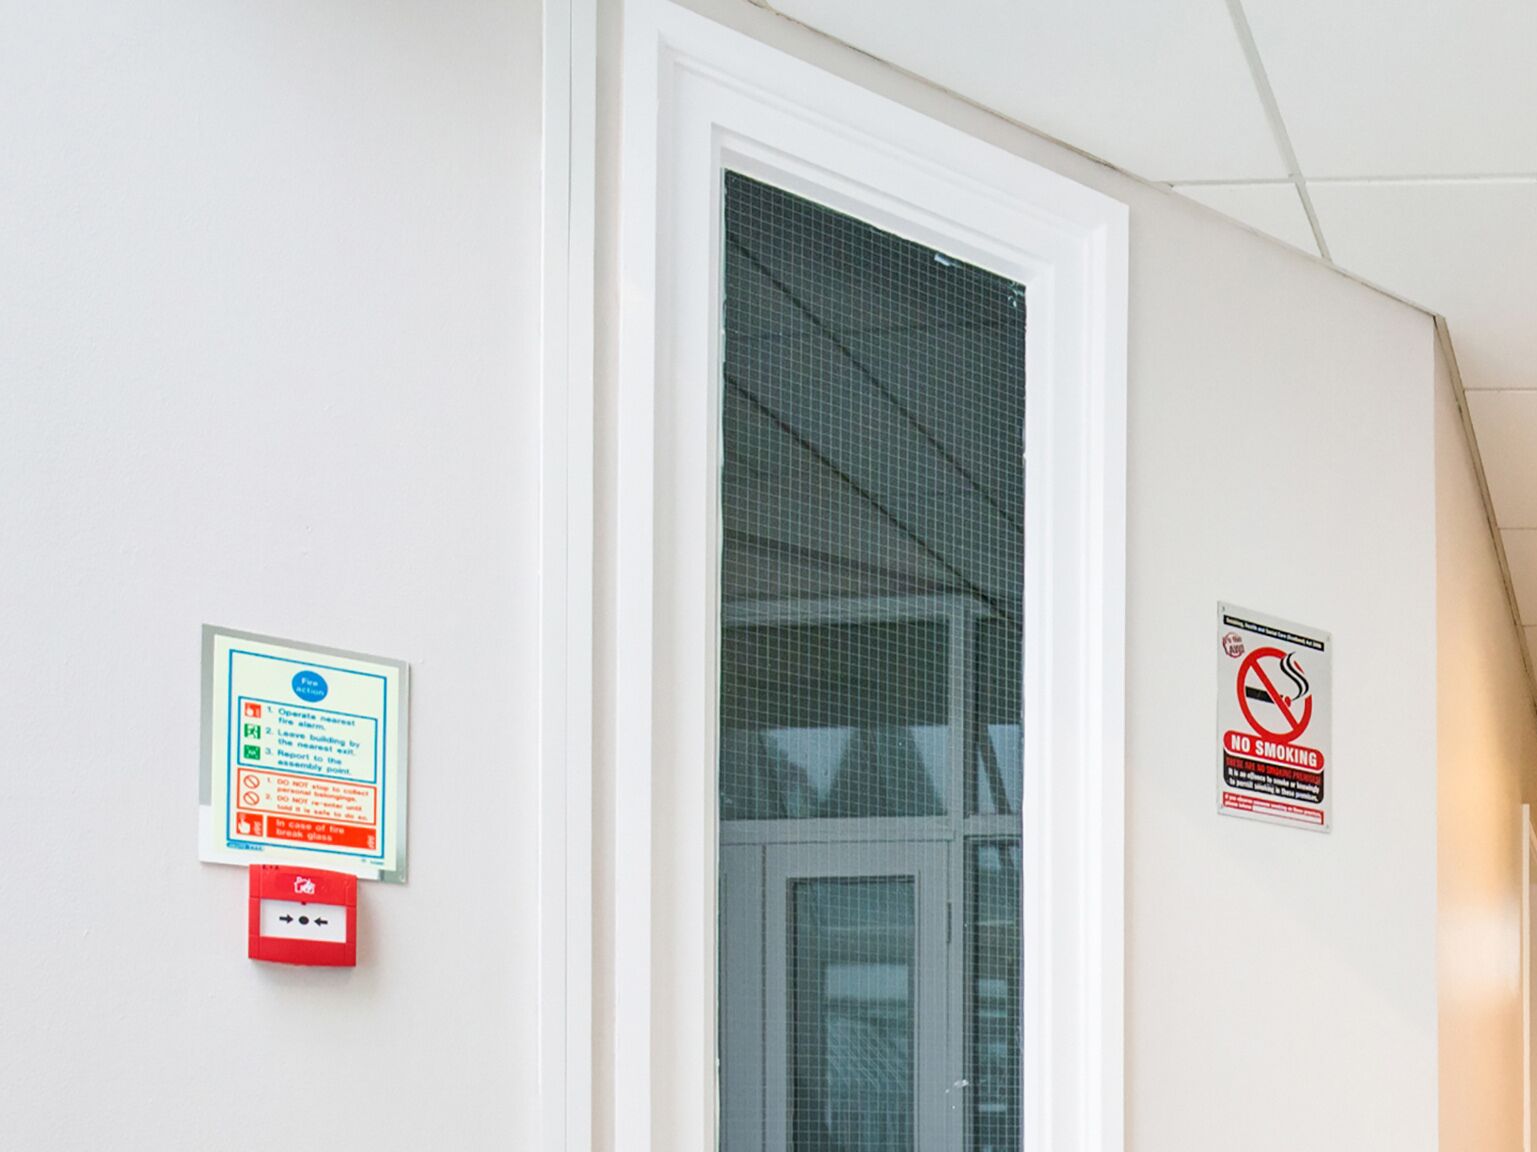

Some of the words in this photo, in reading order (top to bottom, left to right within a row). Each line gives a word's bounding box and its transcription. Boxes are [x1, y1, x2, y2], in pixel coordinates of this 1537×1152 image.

[301, 677, 318, 686] Fire
[296, 687, 324, 696] action
[278, 708, 316, 720] Operate
[320, 713, 355, 726] nearest
[278, 717, 293, 725] fire
[298, 722, 325, 730] alarm.
[278, 730, 305, 739] Leave
[310, 735, 345, 747] building
[350, 740, 360, 748] by
[298, 742, 332, 752] nearest
[1232, 734, 1250, 752] NO
[1255, 740, 1317, 767] SMOKING
[278, 750, 309, 762] Report
[314, 754, 323, 762] to
[328, 757, 341, 765] the
[278, 760, 322, 771] assembly
[327, 766, 351, 775] point.
[277, 787, 311, 796] personal
[292, 780, 309, 788] NOT
[312, 784, 329, 792] stop
[344, 787, 369, 796] collect
[312, 800, 342, 809] re-enter
[314, 808, 330, 816] safe
[276, 819, 285, 827] In
[288, 821, 311, 830] case
[316, 823, 325, 831] of
[330, 825, 344, 834] fire
[276, 829, 303, 838] break
[307, 832, 332, 842] glass
